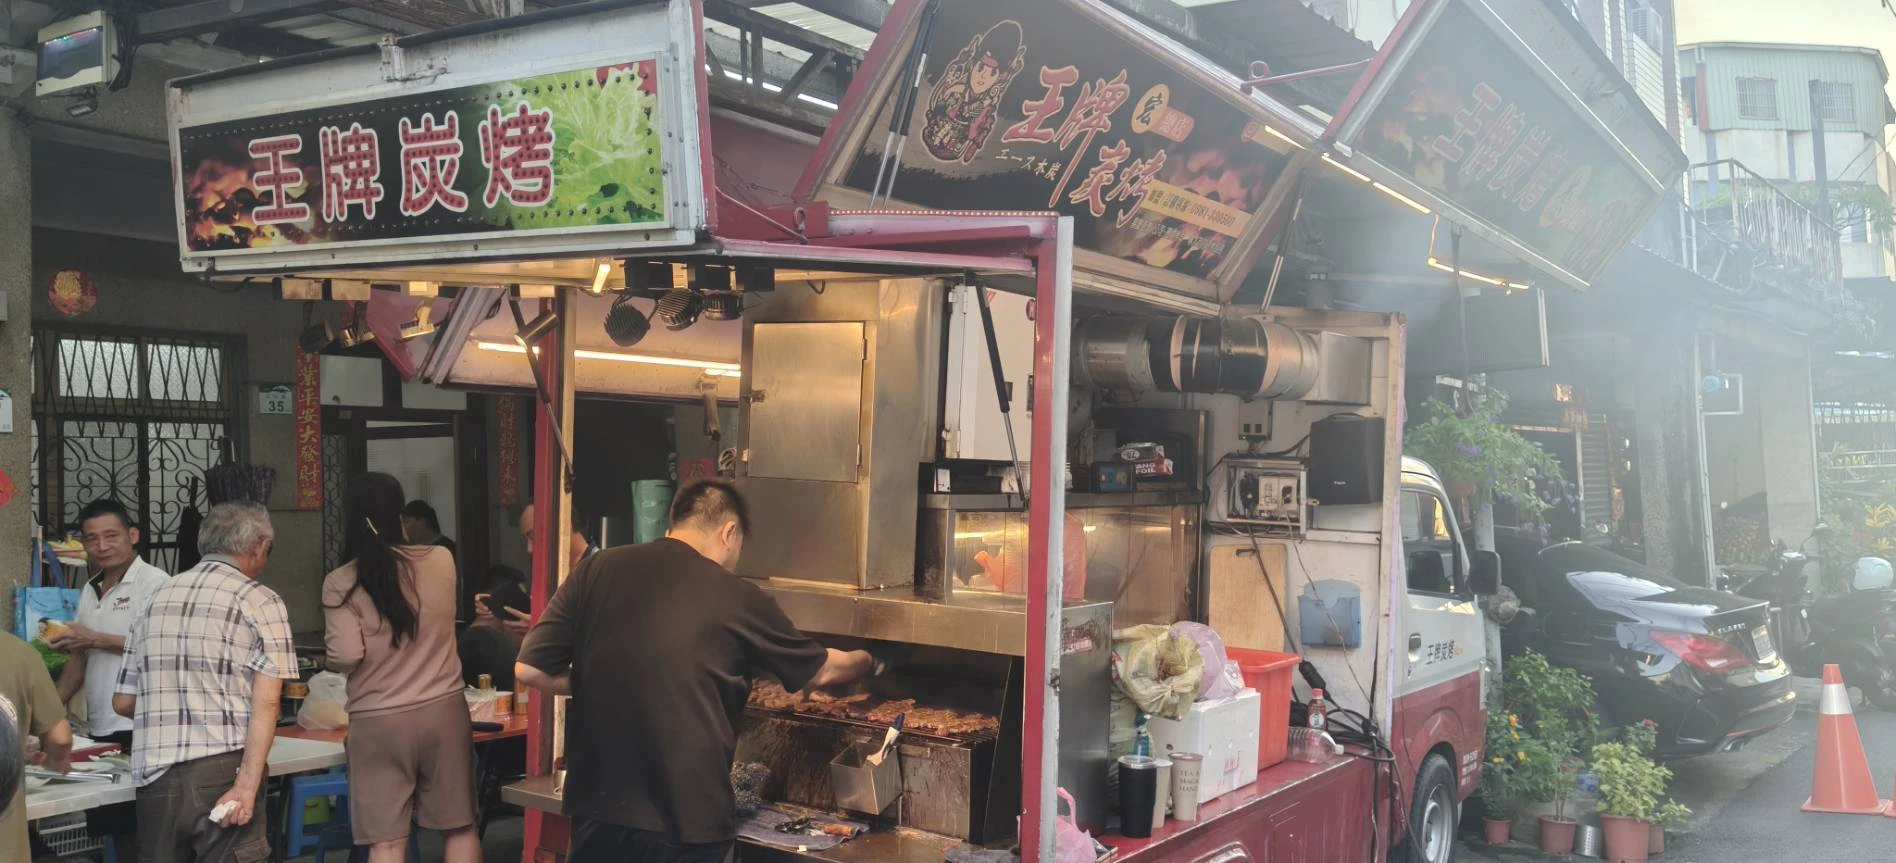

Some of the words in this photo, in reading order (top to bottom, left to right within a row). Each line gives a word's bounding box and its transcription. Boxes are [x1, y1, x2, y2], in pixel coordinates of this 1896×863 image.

[248, 103, 556, 224] 王牌炭烤
[1002, 64, 1130, 208] 王牌
[1068, 139, 1167, 229] 炭烤
[268, 400, 285, 412] 35
